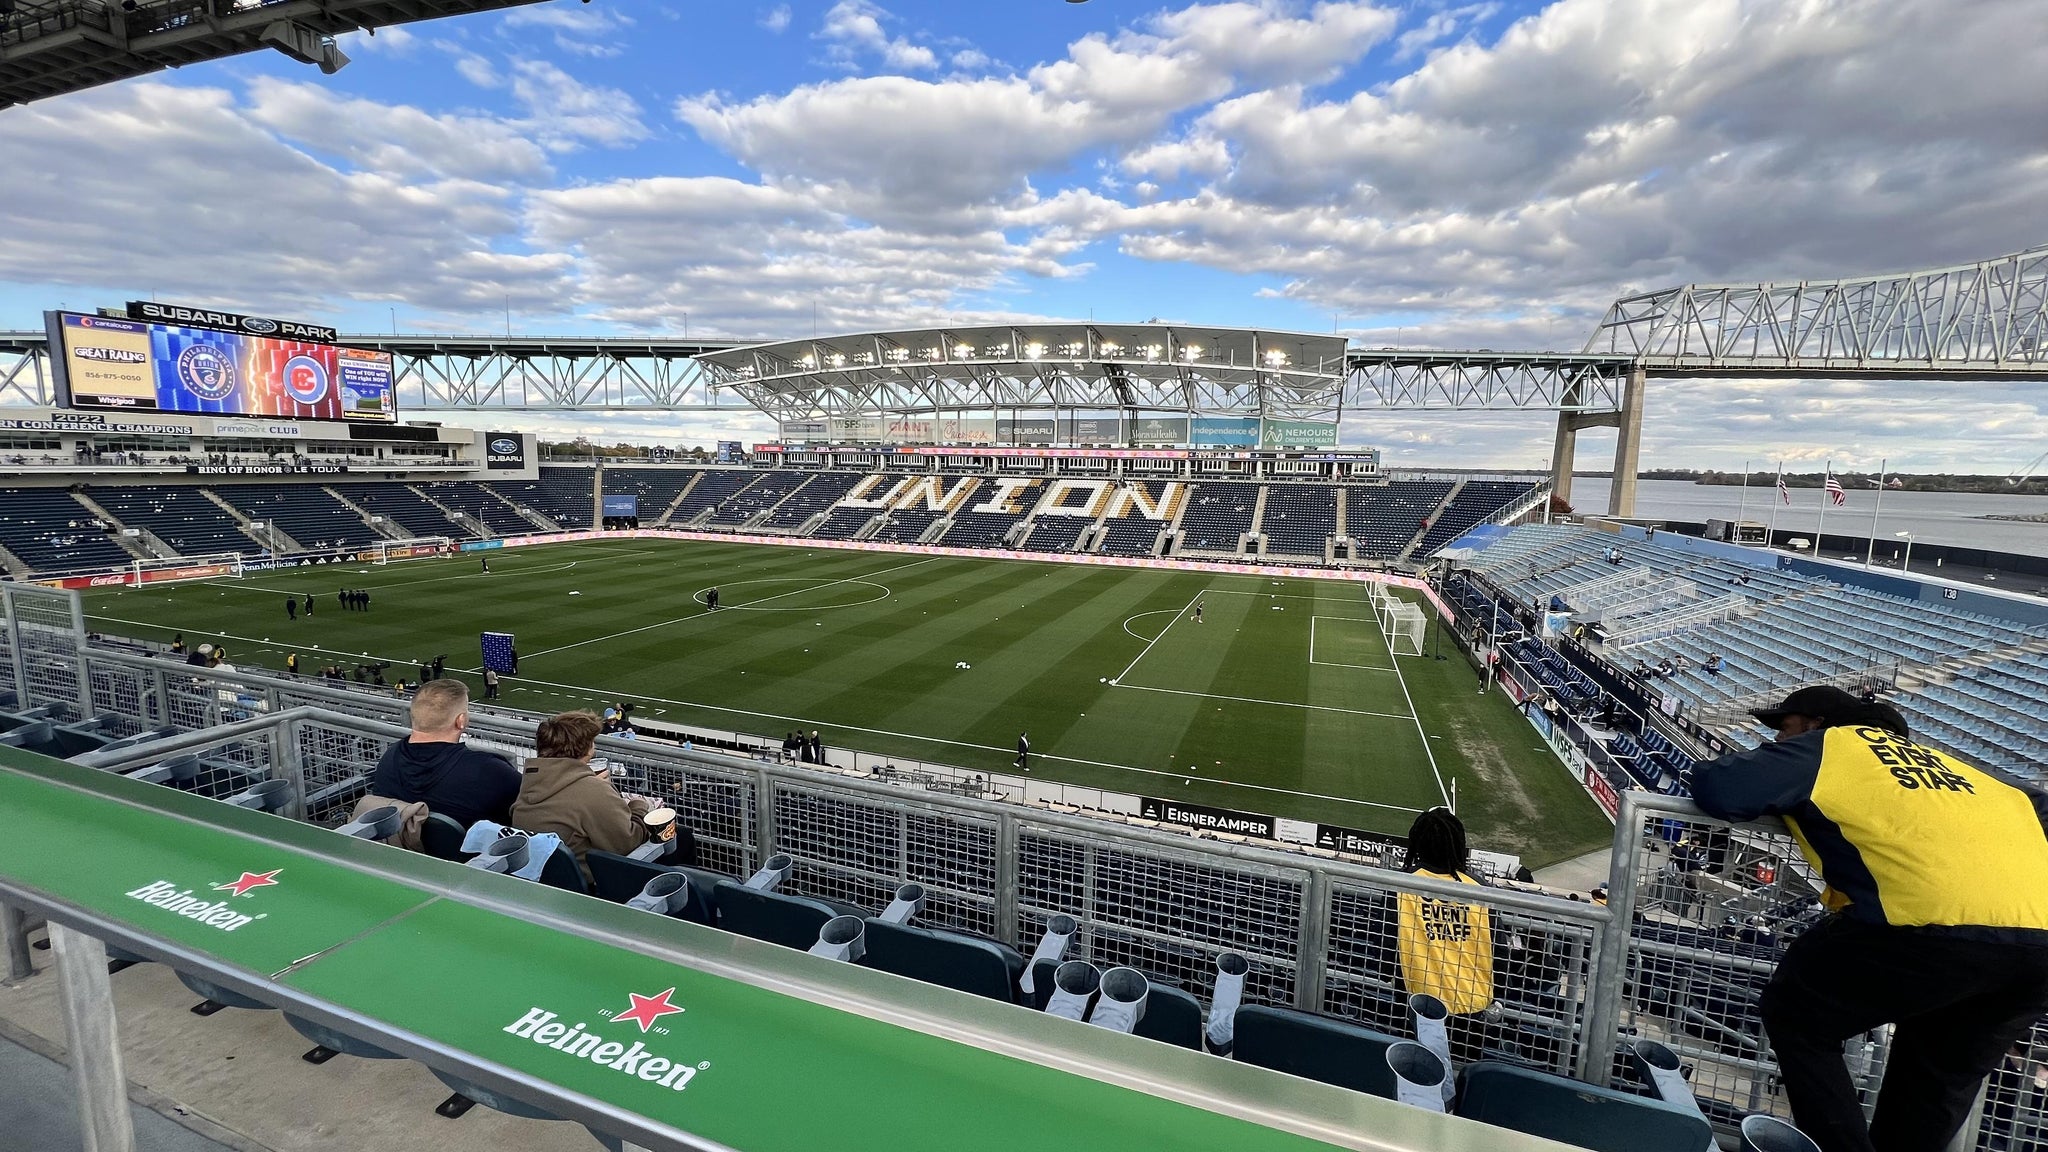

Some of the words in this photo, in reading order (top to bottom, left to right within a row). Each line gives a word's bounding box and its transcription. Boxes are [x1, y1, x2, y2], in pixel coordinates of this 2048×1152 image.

[94, 321, 133, 330] cantaloupe
[142, 304, 237, 327] SUBARU
[281, 323, 334, 340] PARK
[75, 348, 106, 358] GREAT
[109, 351, 145, 362] RAILING
[181, 345, 233, 374] PHILADELPHIA
[85, 372, 142, 381] 856-875-0050
[98, 396, 136, 406] Whirlpool
[55, 414, 102, 423] 2022
[21, 421, 115, 432] CONFERENCE
[116, 424, 192, 434] CHAMPIONS
[217, 424, 267, 433] primepoint
[269, 426, 299, 435] CLUB
[834, 420, 861, 429] WSFS
[889, 421, 930, 433] GIANT
[1013, 427, 1053, 435] SUBARU
[1192, 427, 1248, 436] Independence
[1285, 429, 1334, 437] NEMOURS
[198, 466, 227, 474] RING
[228, 466, 243, 474] OF
[245, 466, 283, 474] HONOR
[842, 474, 1187, 521] UNION
[90, 575, 125, 586] Coca-Cola
[1943, 588, 1957, 599] 138
[1890, 767, 1976, 795] STAFF
[125, 880, 253, 931] Heineken
[1421, 903, 1470, 924] EVENT
[1425, 923, 1471, 942] STAFF
[502, 1006, 697, 1091] Heineken
